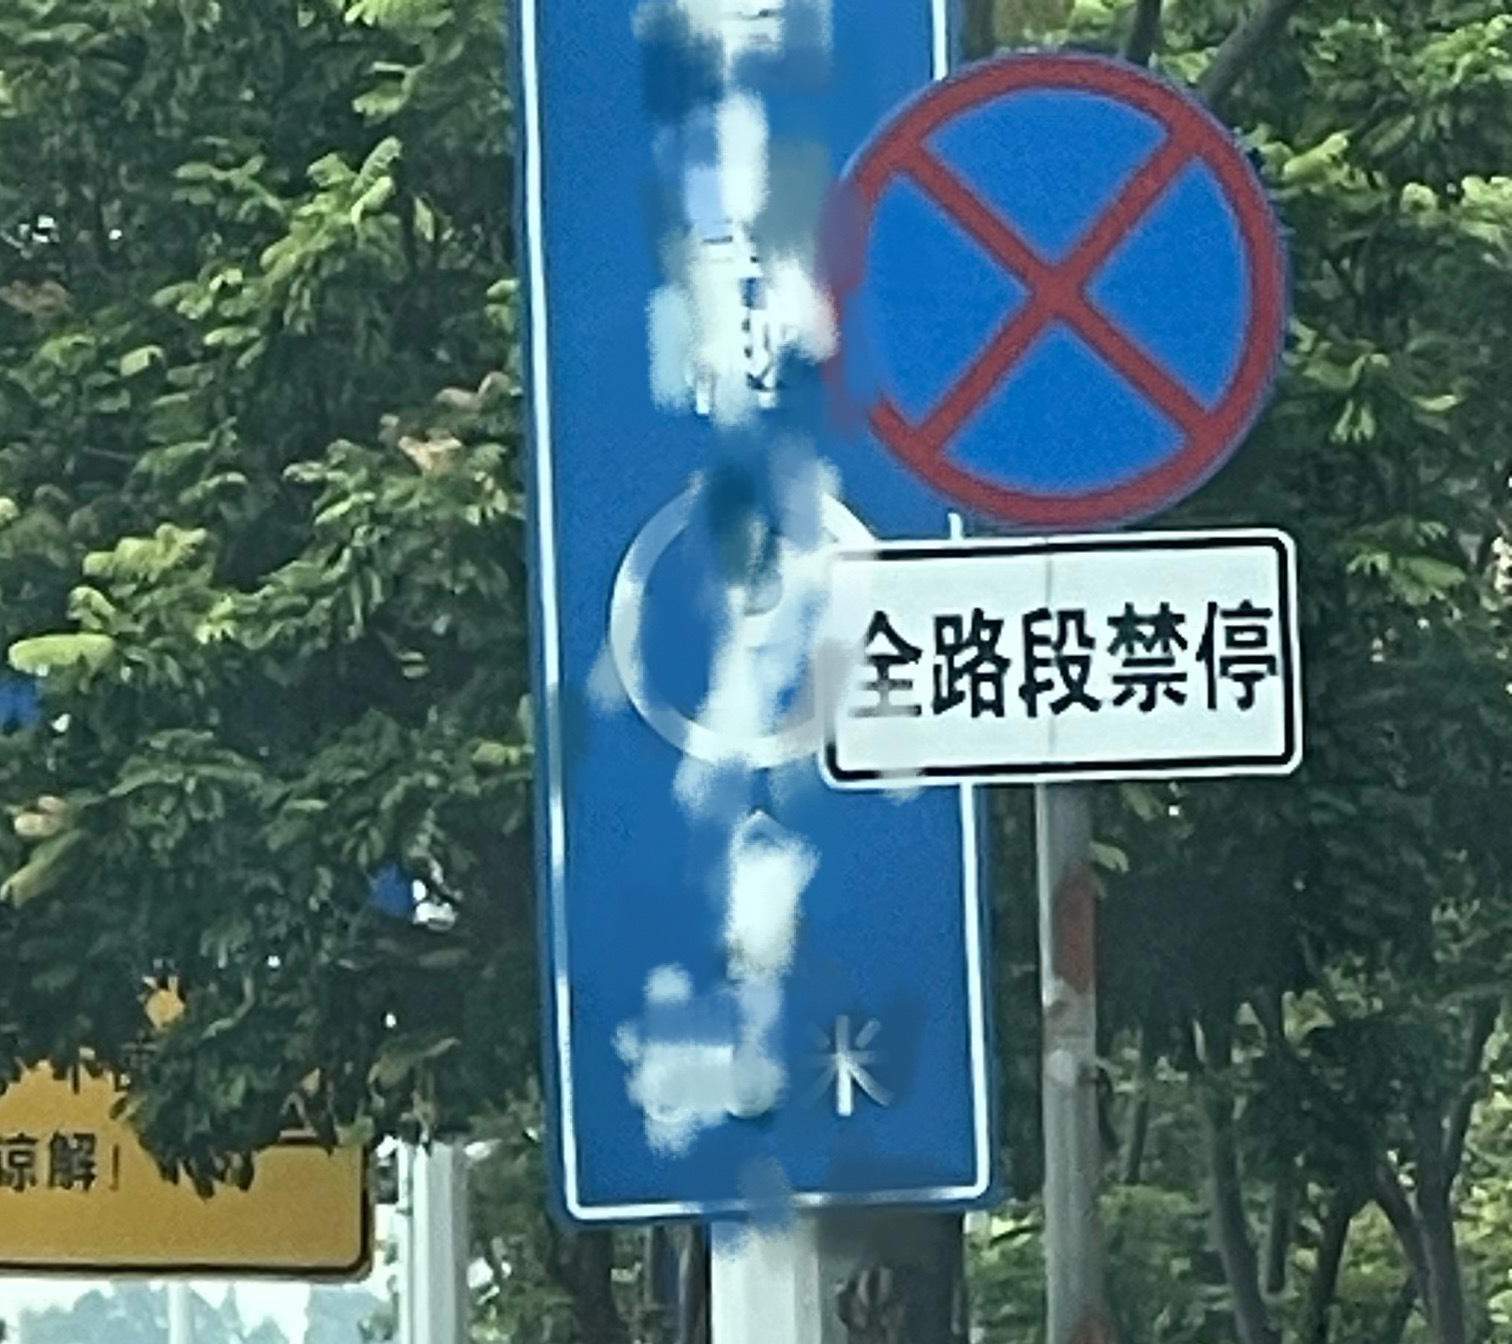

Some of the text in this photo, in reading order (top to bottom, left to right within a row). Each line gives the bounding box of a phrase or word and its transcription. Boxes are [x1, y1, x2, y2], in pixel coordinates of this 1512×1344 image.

[849, 600, 1278, 719] 全路段禁停
